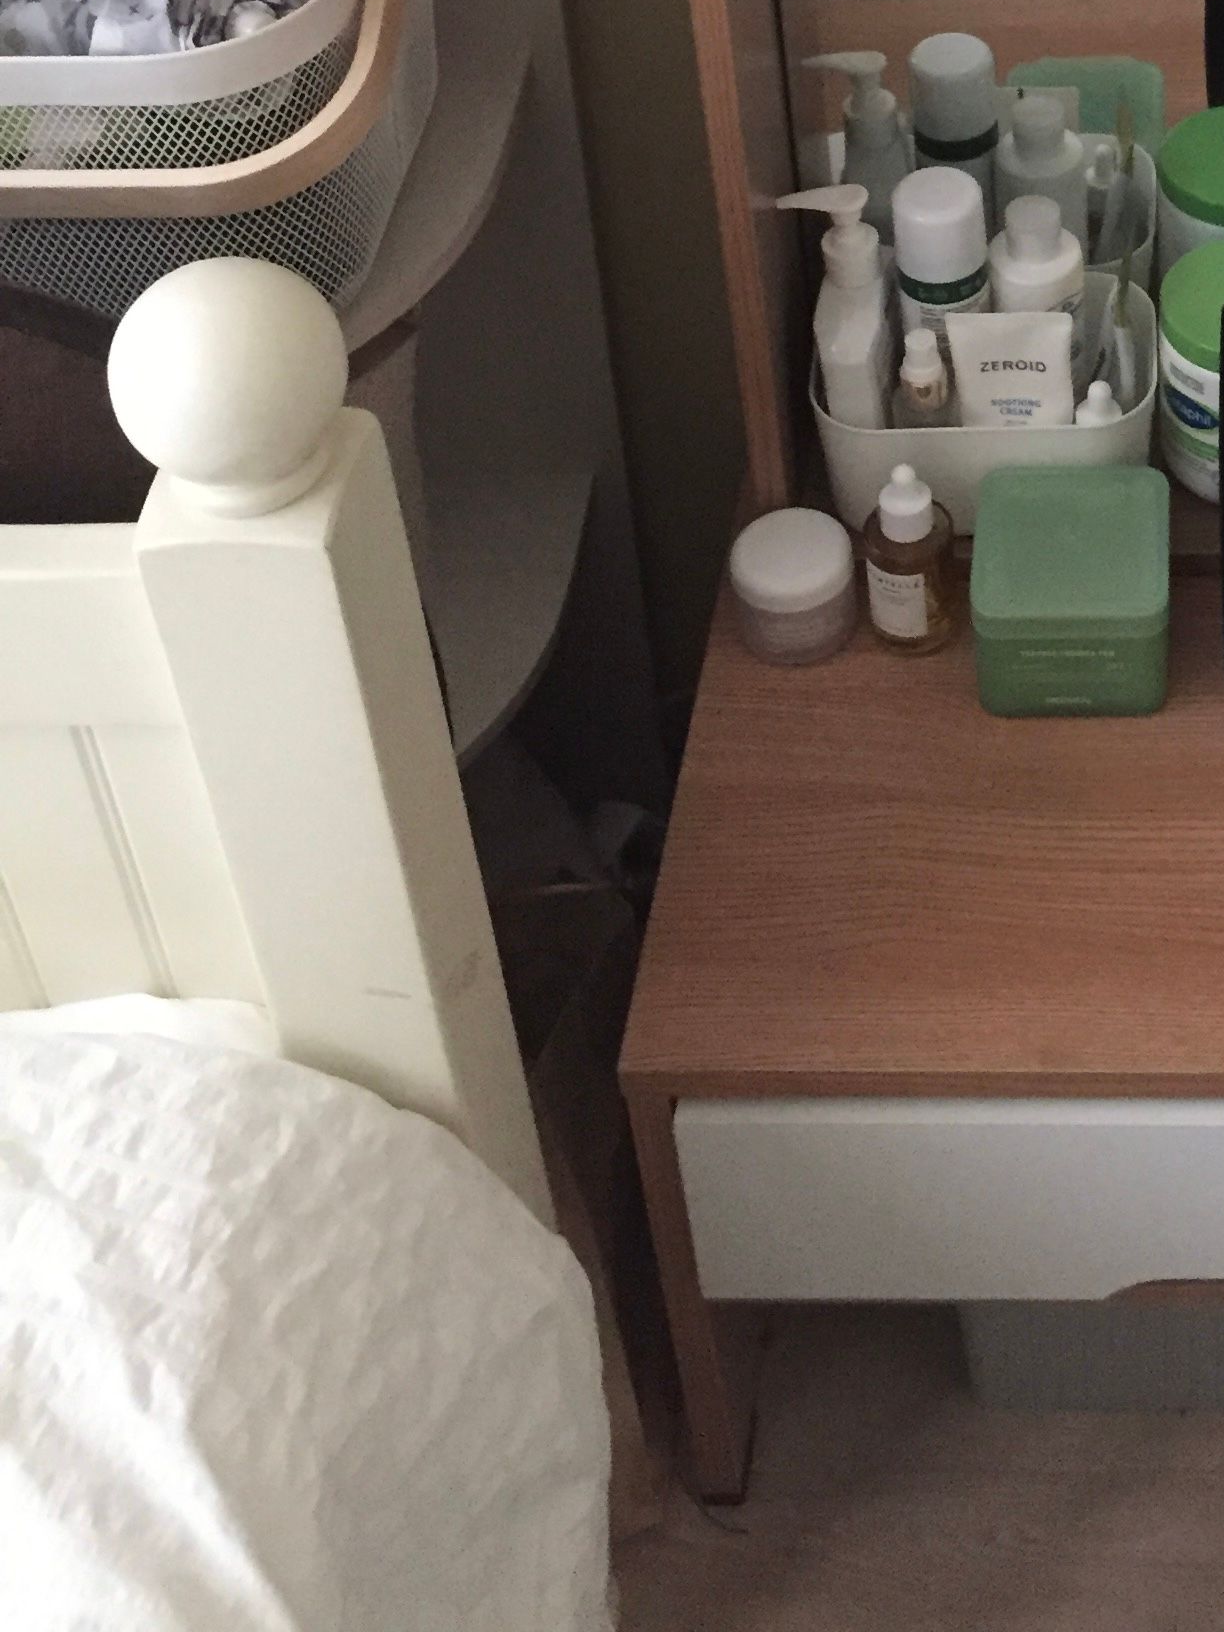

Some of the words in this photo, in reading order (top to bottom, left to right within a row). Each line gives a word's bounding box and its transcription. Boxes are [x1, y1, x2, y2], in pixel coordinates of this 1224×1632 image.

[979, 359, 1047, 373] ZEROID
[990, 398, 1042, 408] SOOTHING
[999, 407, 1033, 417] CREAM
